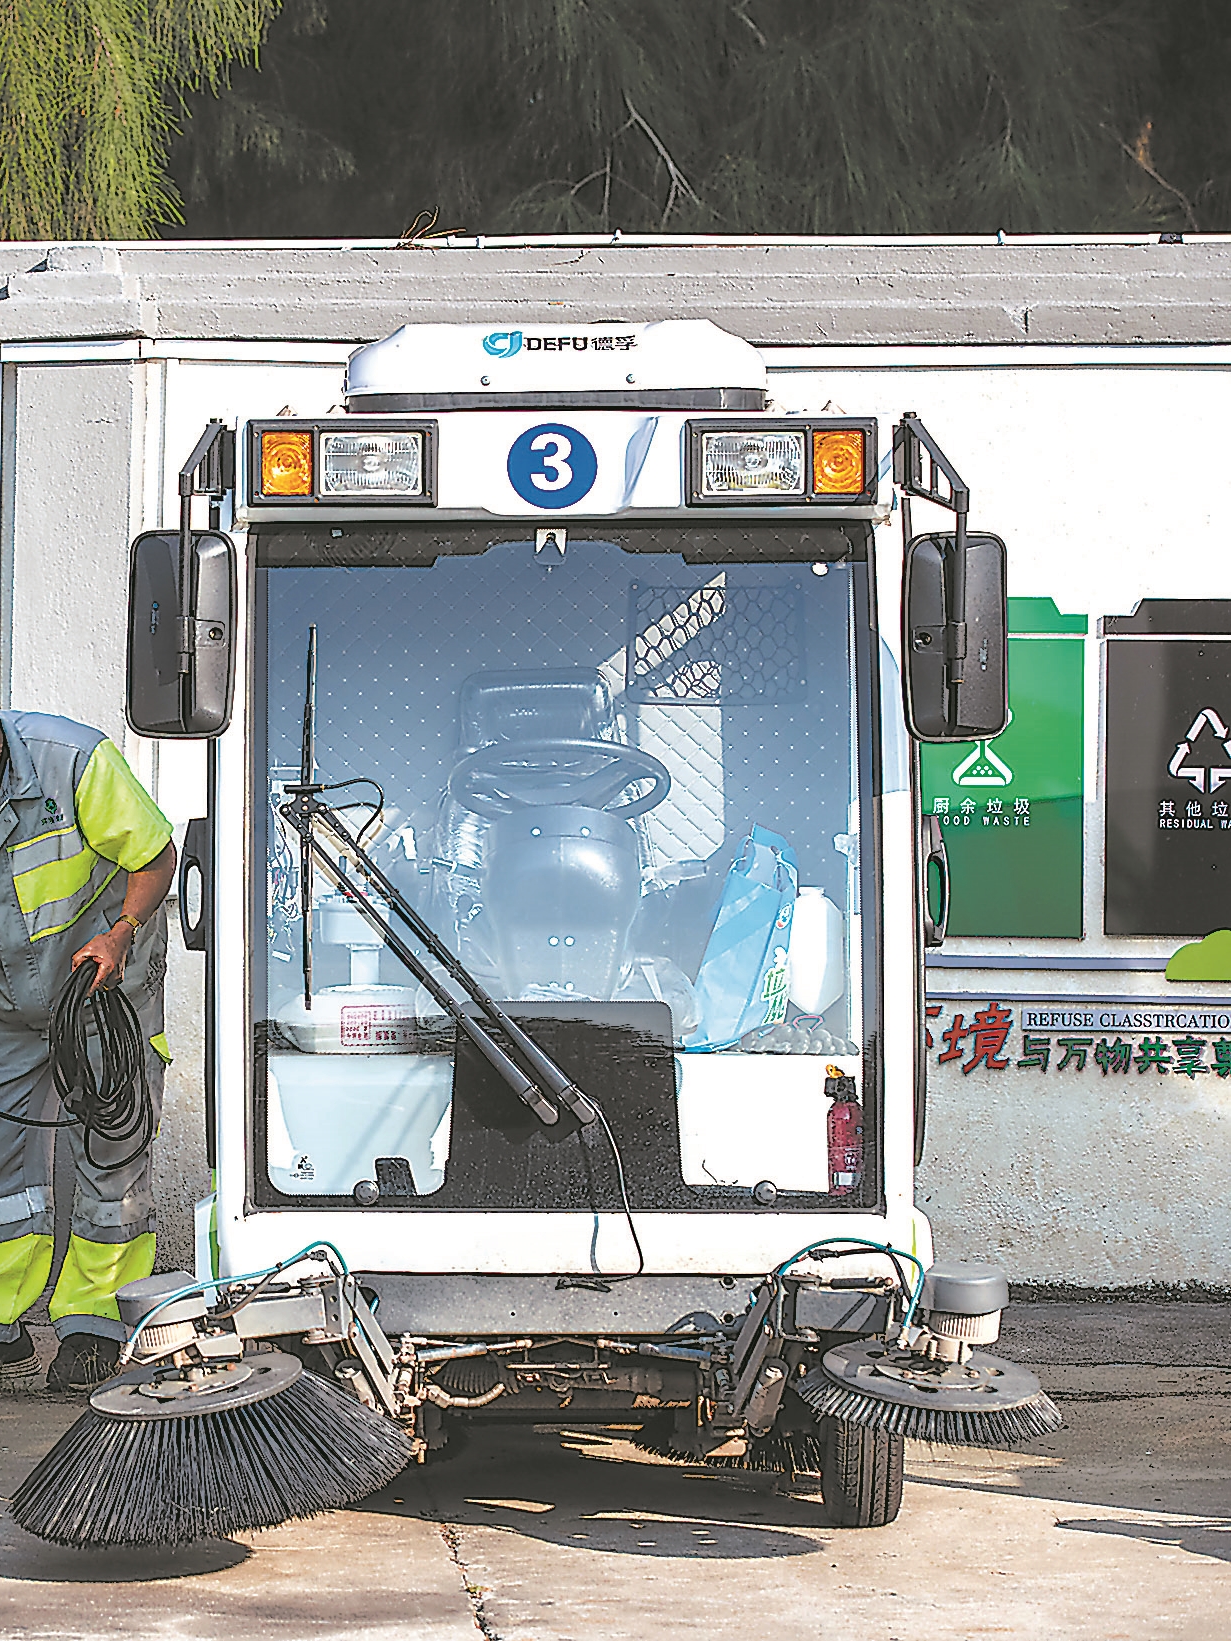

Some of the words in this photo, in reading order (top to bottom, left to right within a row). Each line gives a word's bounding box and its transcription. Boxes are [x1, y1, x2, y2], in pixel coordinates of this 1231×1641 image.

[526, 336, 588, 351] DEFU
[591, 335, 638, 351] 德孚
[530, 432, 574, 492] 3
[932, 797, 1030, 815] 厨余垃圾
[1158, 800, 1229, 817] 其他垃
[936, 815, 970, 826] OOD
[982, 816, 1030, 826] WASTE
[1159, 818, 1214, 829] RESIDUAL
[1026, 1011, 1094, 1027] REFUSE
